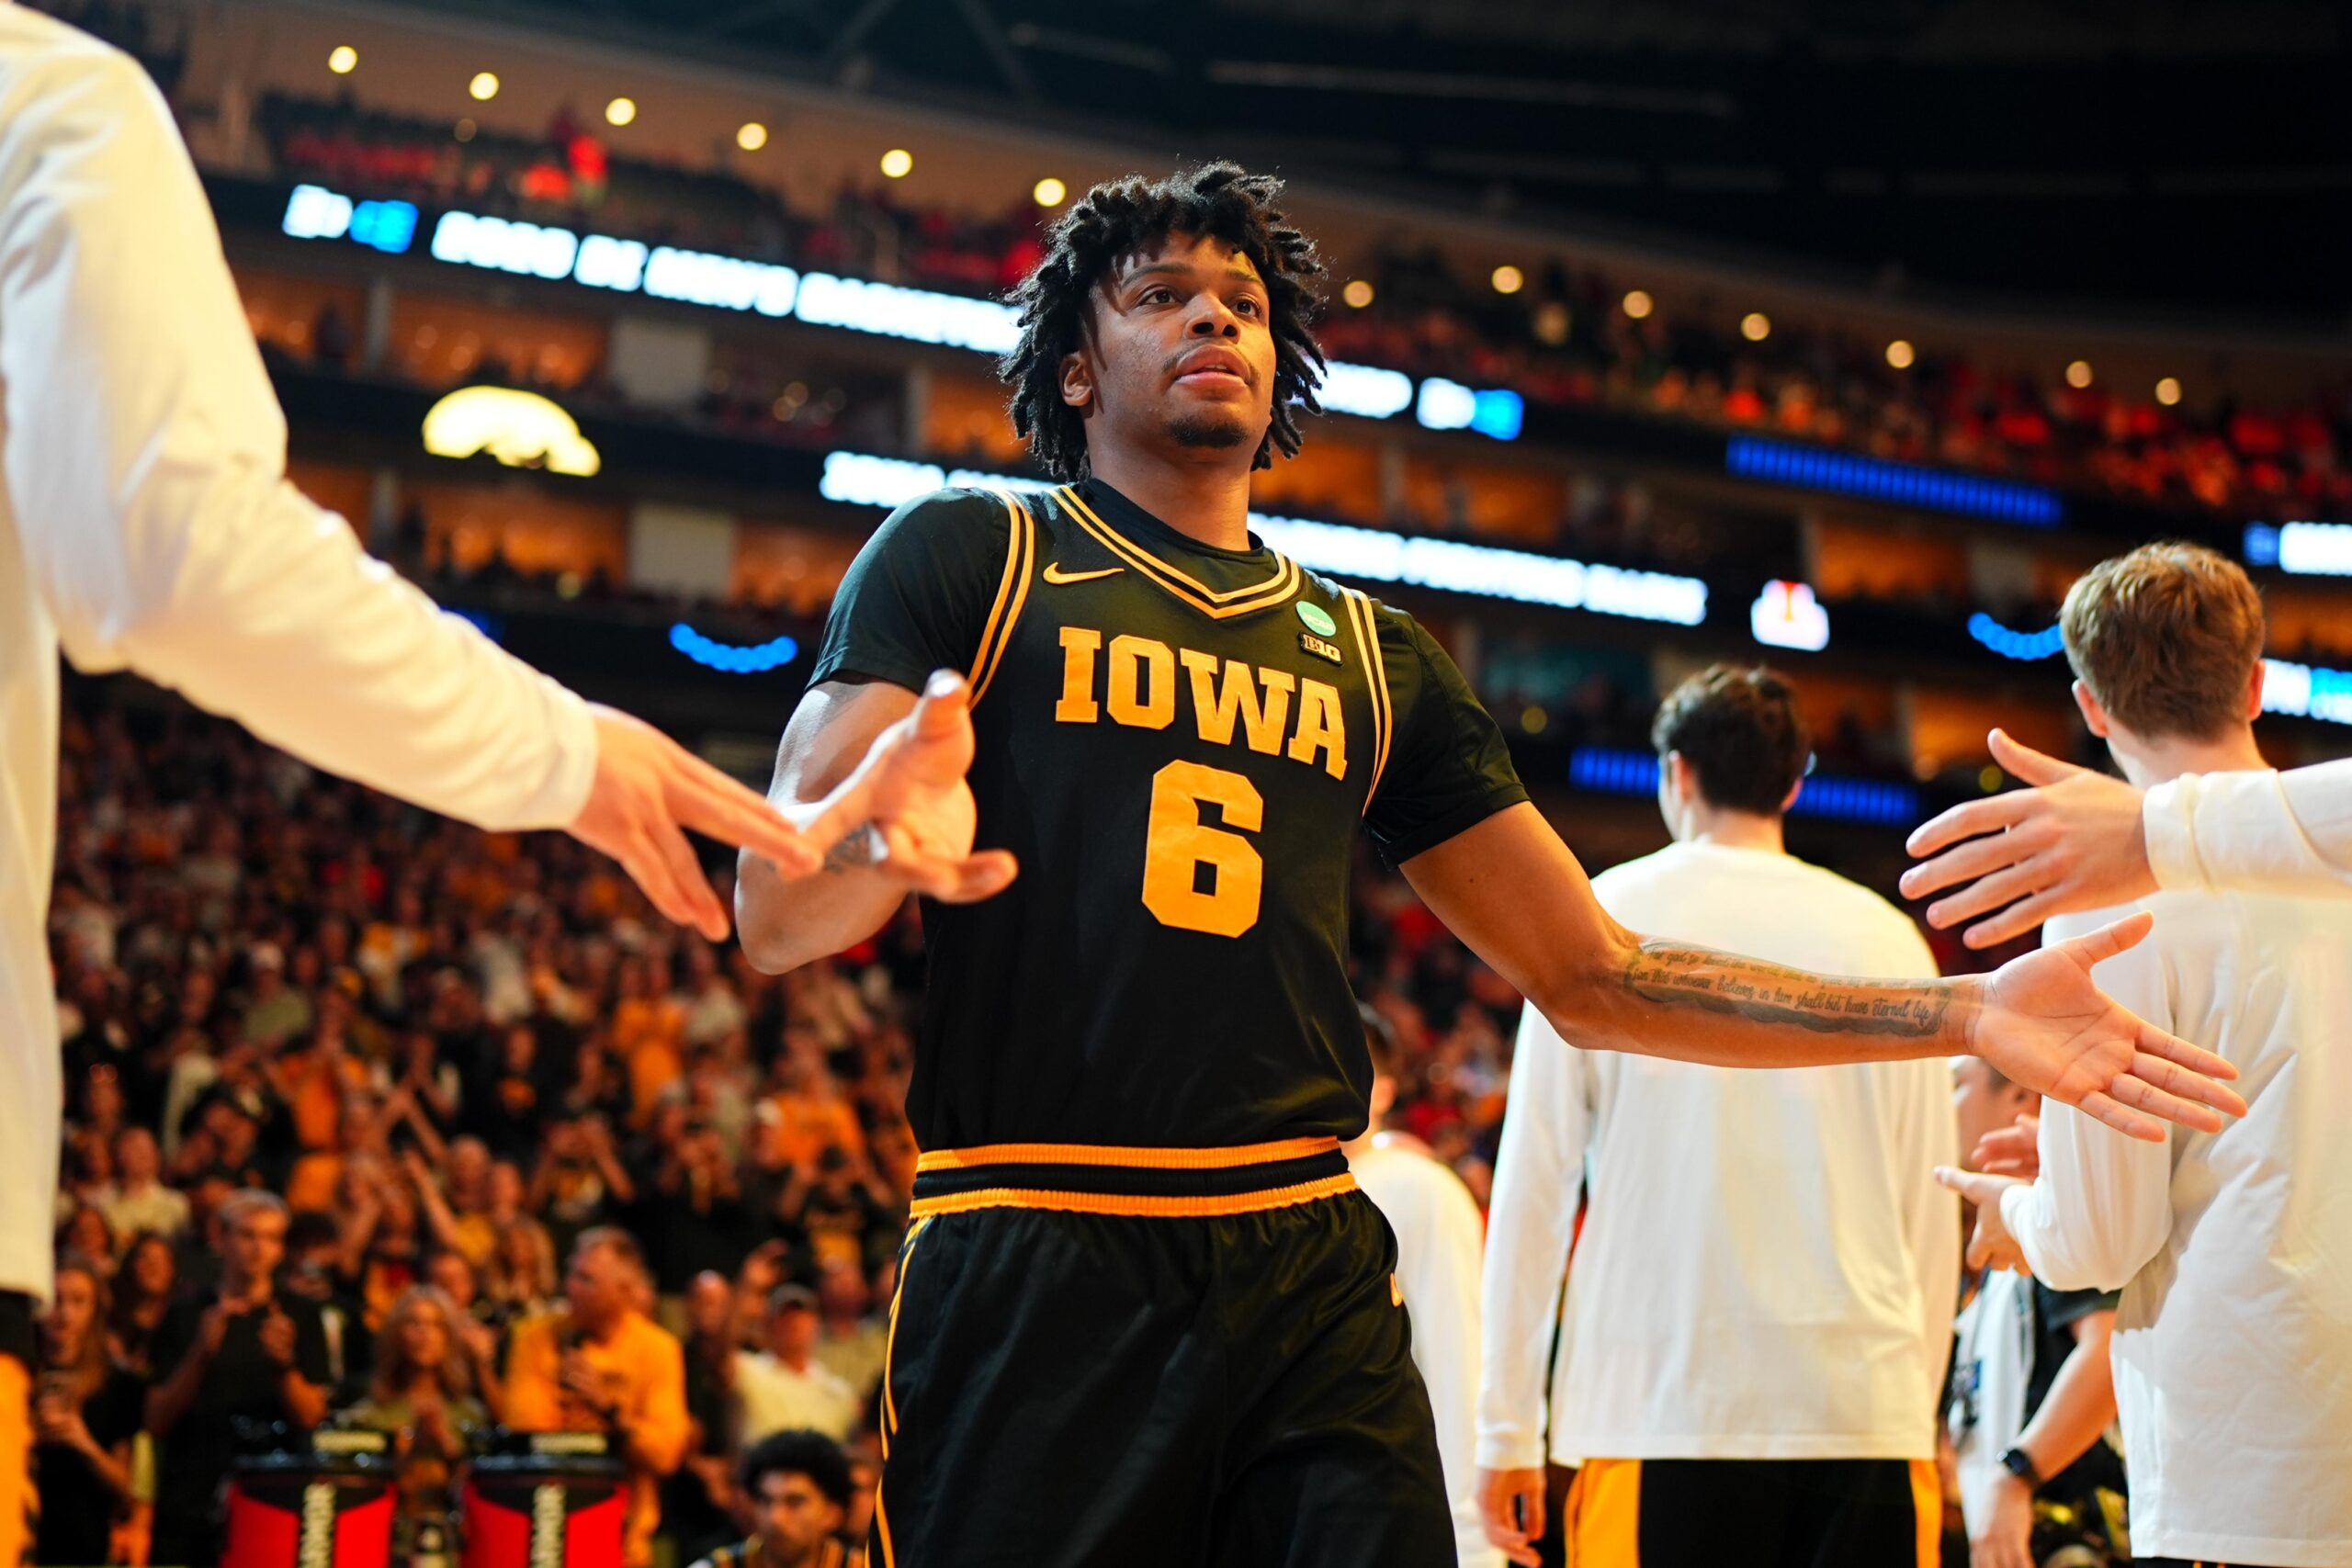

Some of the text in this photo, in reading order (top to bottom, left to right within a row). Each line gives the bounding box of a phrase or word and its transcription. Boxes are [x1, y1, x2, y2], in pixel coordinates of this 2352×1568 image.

[1055, 626, 1348, 781] IOWA
[1141, 760, 1263, 939] 6
[1758, 987, 1770, 1000] in
[1773, 987, 1793, 1003] him
[1794, 991, 1826, 1010] shall
[1845, 995, 1869, 1015] have
[1912, 1000, 1930, 1029] life
